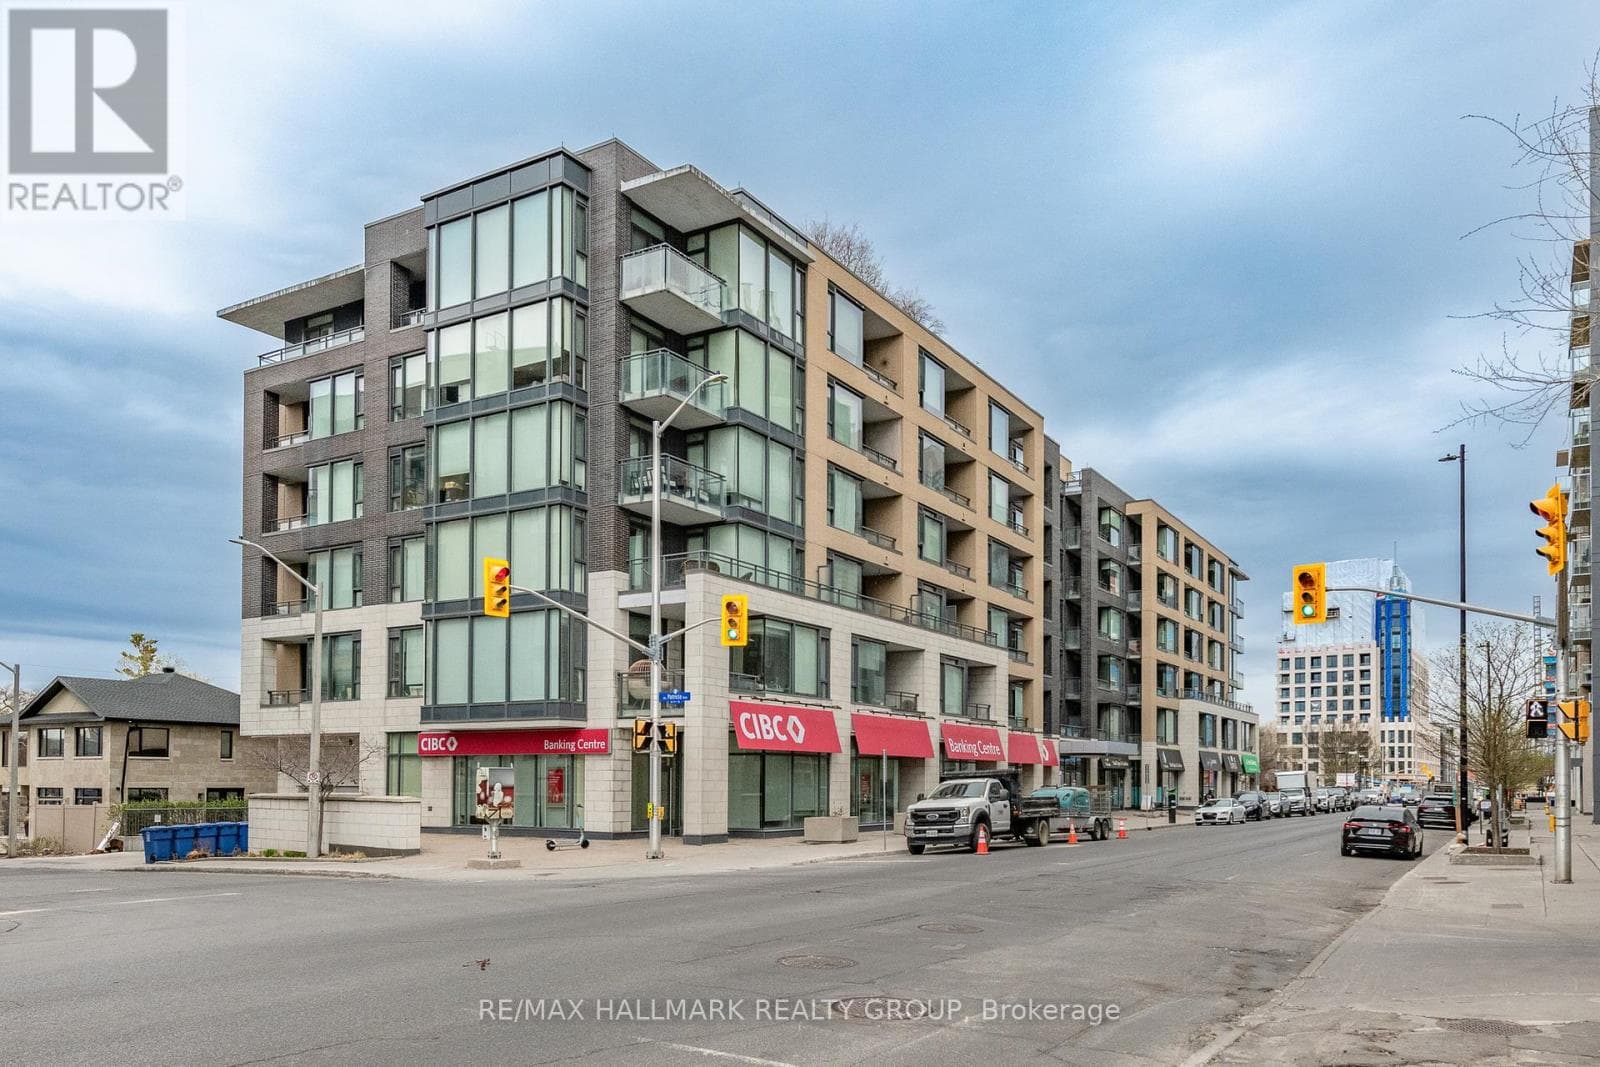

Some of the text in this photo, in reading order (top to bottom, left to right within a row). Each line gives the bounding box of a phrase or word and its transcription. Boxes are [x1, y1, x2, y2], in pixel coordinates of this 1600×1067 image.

[740, 712, 788, 741] CIBC
[420, 737, 446, 751] CIBC
[544, 738, 606, 752] Banking Centre
[948, 738, 1001, 757] Banking Centre
